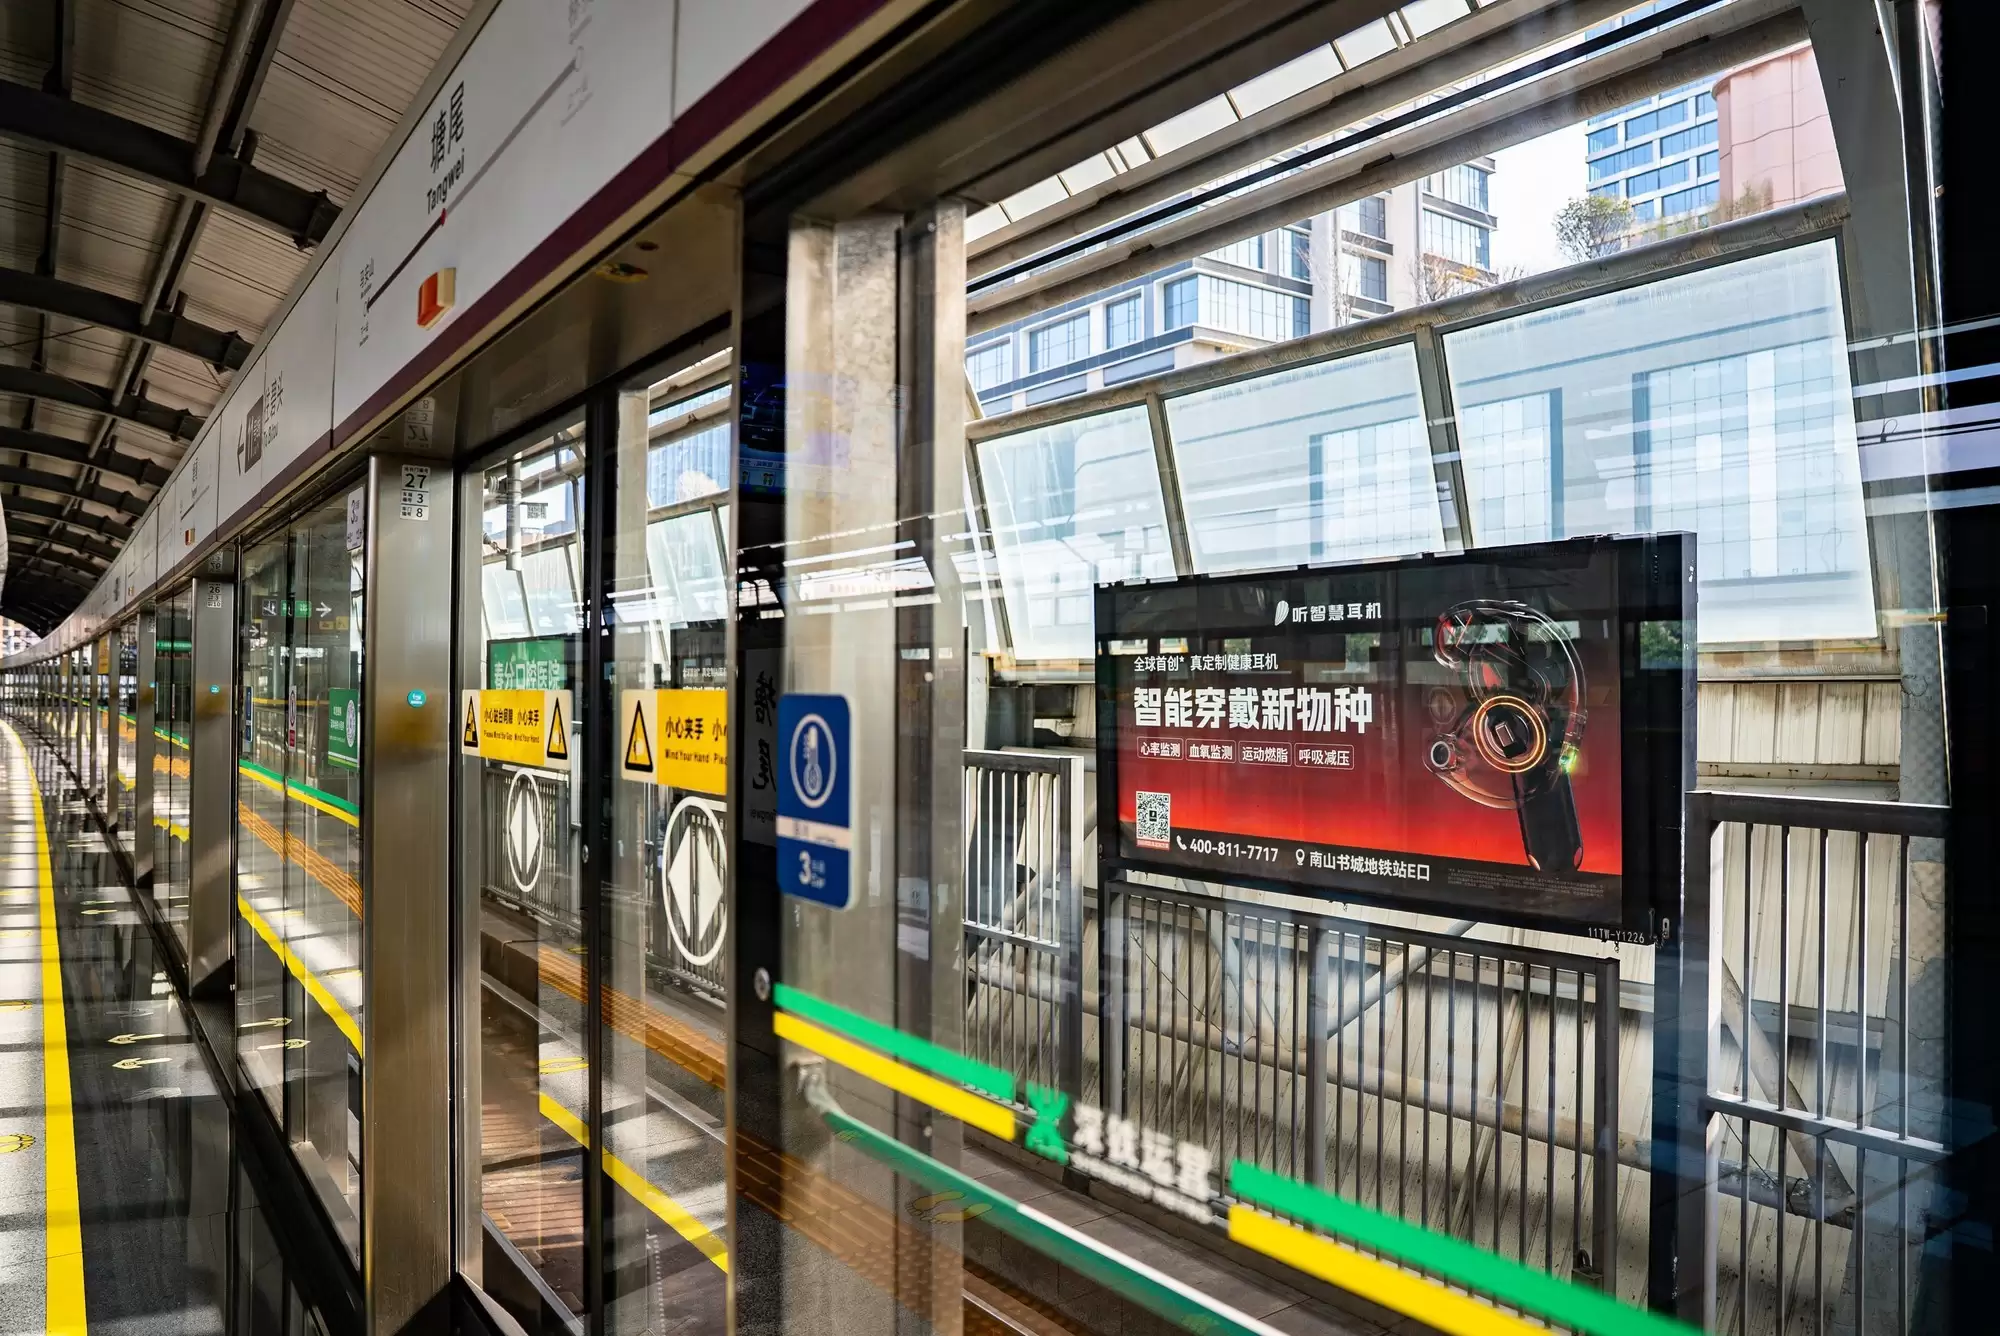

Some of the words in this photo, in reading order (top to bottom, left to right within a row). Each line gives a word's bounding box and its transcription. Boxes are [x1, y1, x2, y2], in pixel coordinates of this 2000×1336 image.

[430, 80, 465, 174] 塘尾
[426, 148, 465, 215] Tangwei
[405, 473, 427, 489] 27
[416, 493, 424, 504] 3
[416, 508, 423, 518] 8
[1292, 602, 1382, 623] 听智慧耳机
[1190, 653, 1279, 671] 真定制健康耳机
[1134, 686, 1373, 734] 智能穿戴新物种
[665, 716, 704, 740] 小心夹手
[1140, 742, 1181, 758] 心率监测
[1189, 743, 1233, 760] 血氧监测
[1242, 746, 1289, 764] 运动燃脂
[1299, 749, 1350, 766] 呼吸减压
[1190, 838, 1279, 862] 400-811-7717
[799, 850, 812, 885] 3
[1309, 850, 1431, 882] 南山书城地铁站E口
[1588, 926, 1646, 944] 11TW-Y1226
